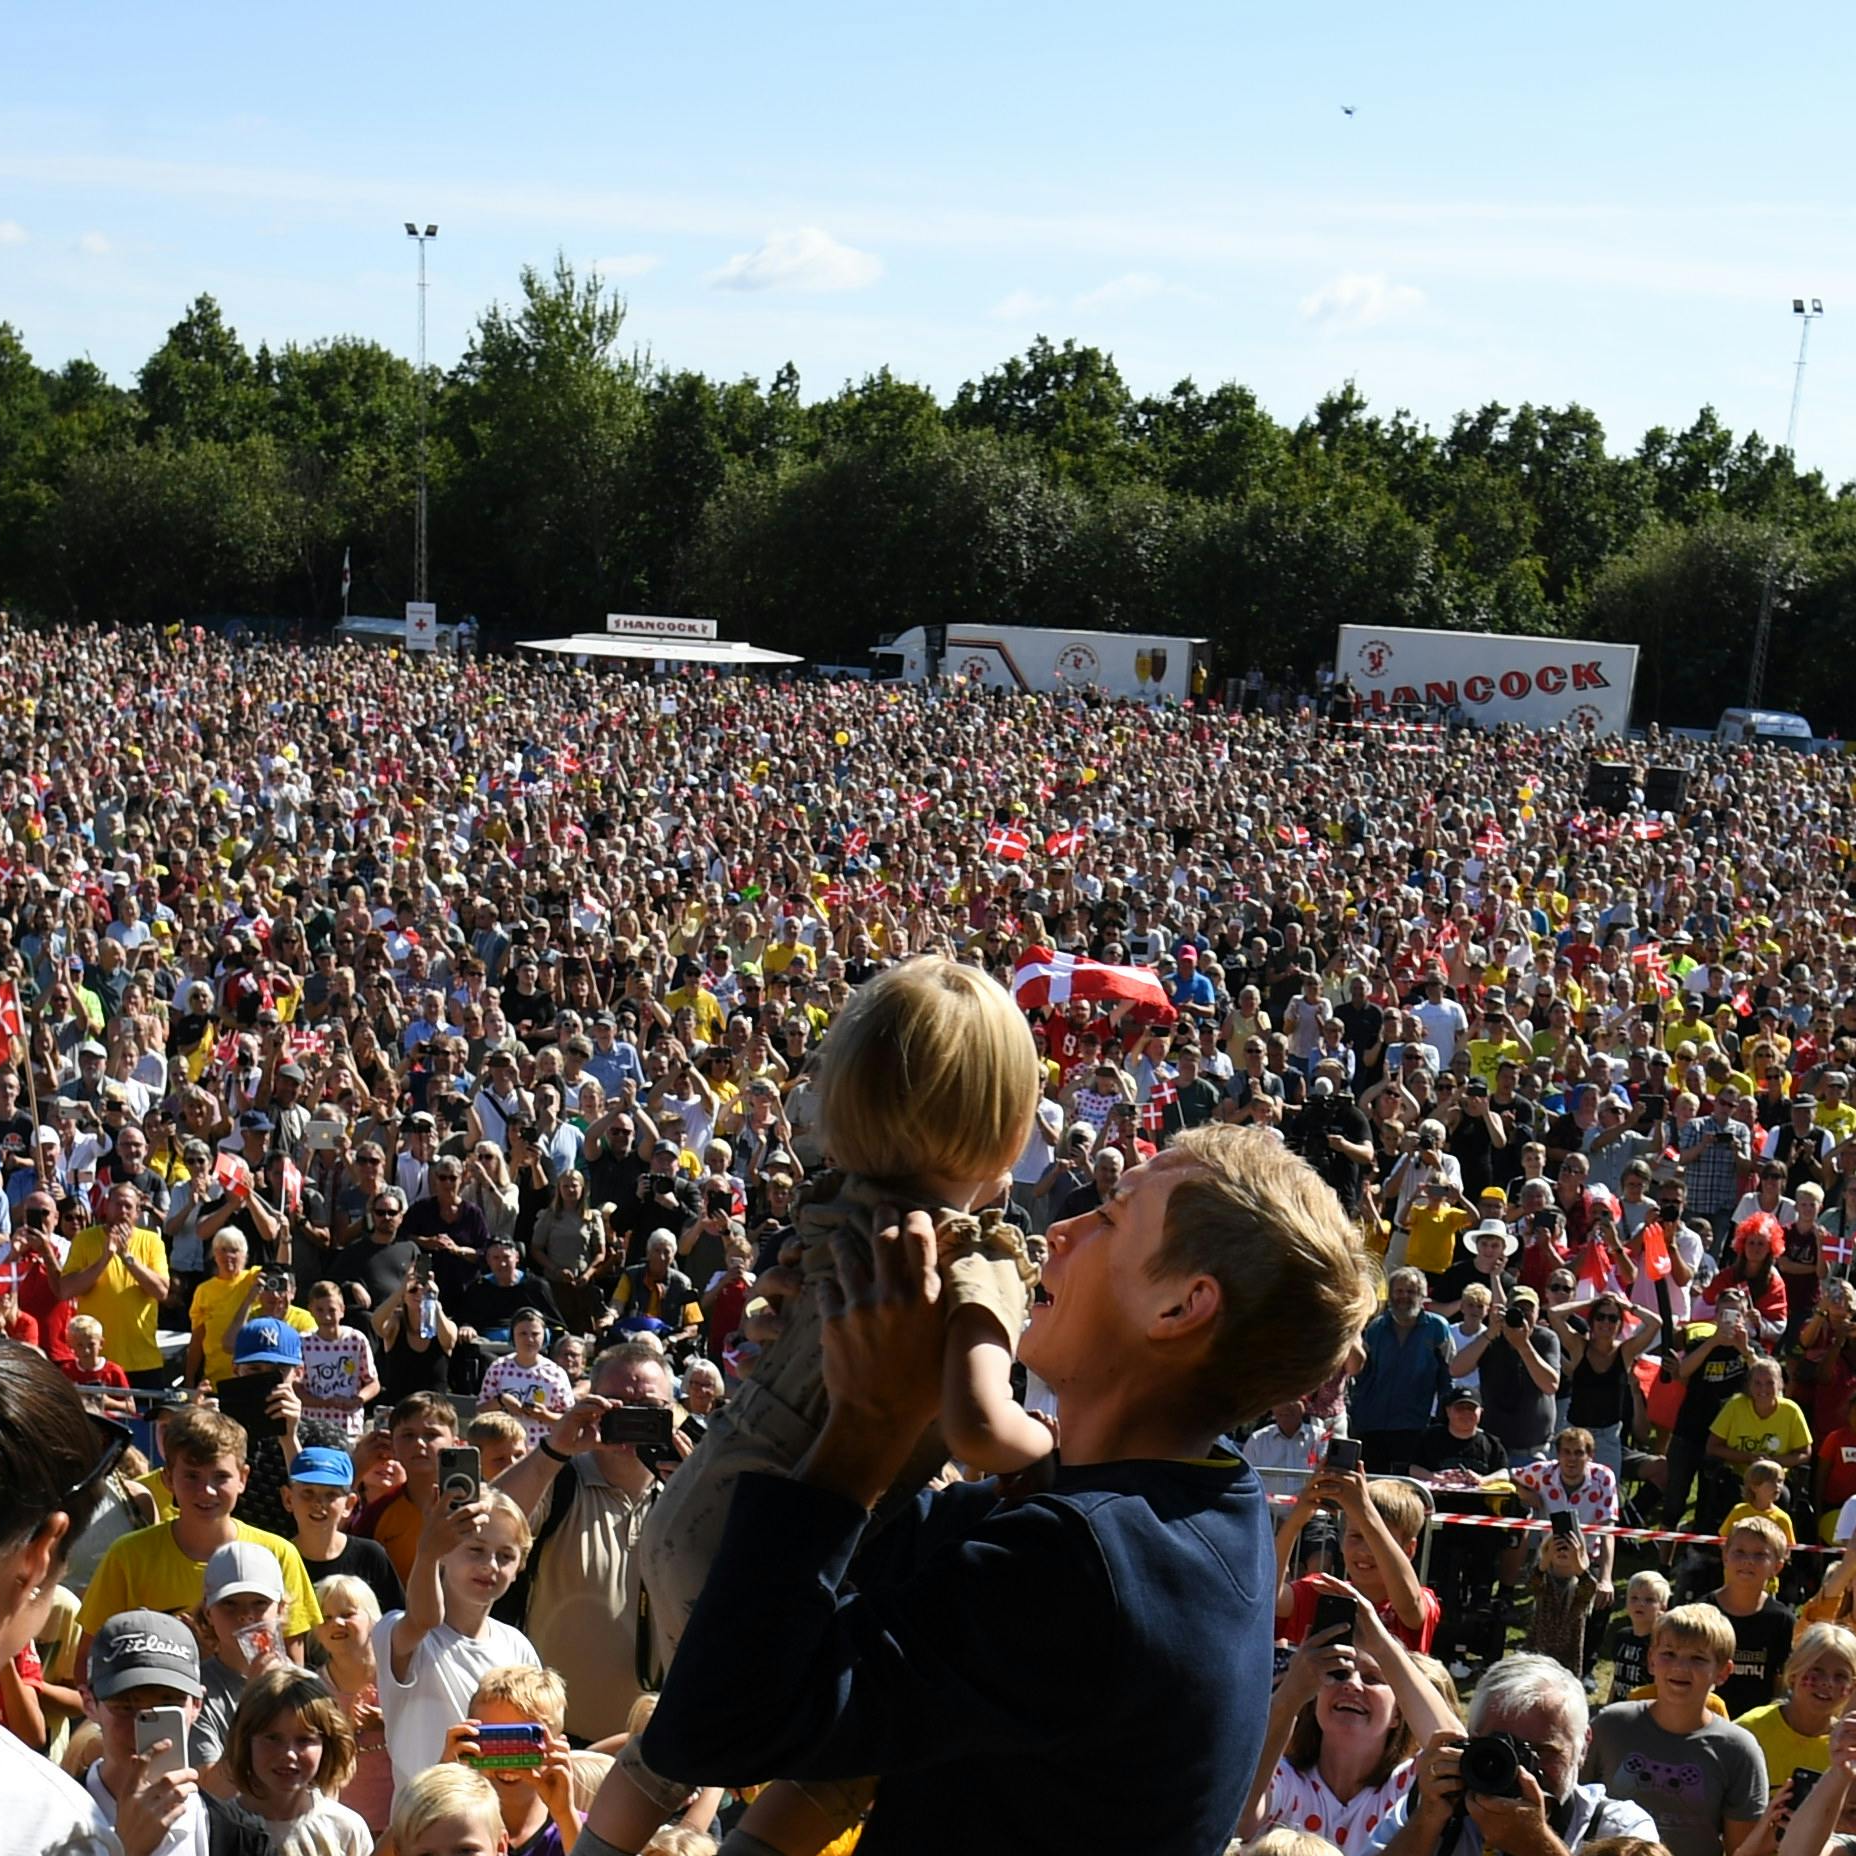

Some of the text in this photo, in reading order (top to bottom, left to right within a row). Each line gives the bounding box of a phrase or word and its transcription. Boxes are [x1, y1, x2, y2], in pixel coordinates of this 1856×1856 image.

[623, 620, 699, 633] HANCOCK
[1352, 660, 1610, 718] HANCOCK
[104, 1632, 191, 1662] Titleist
